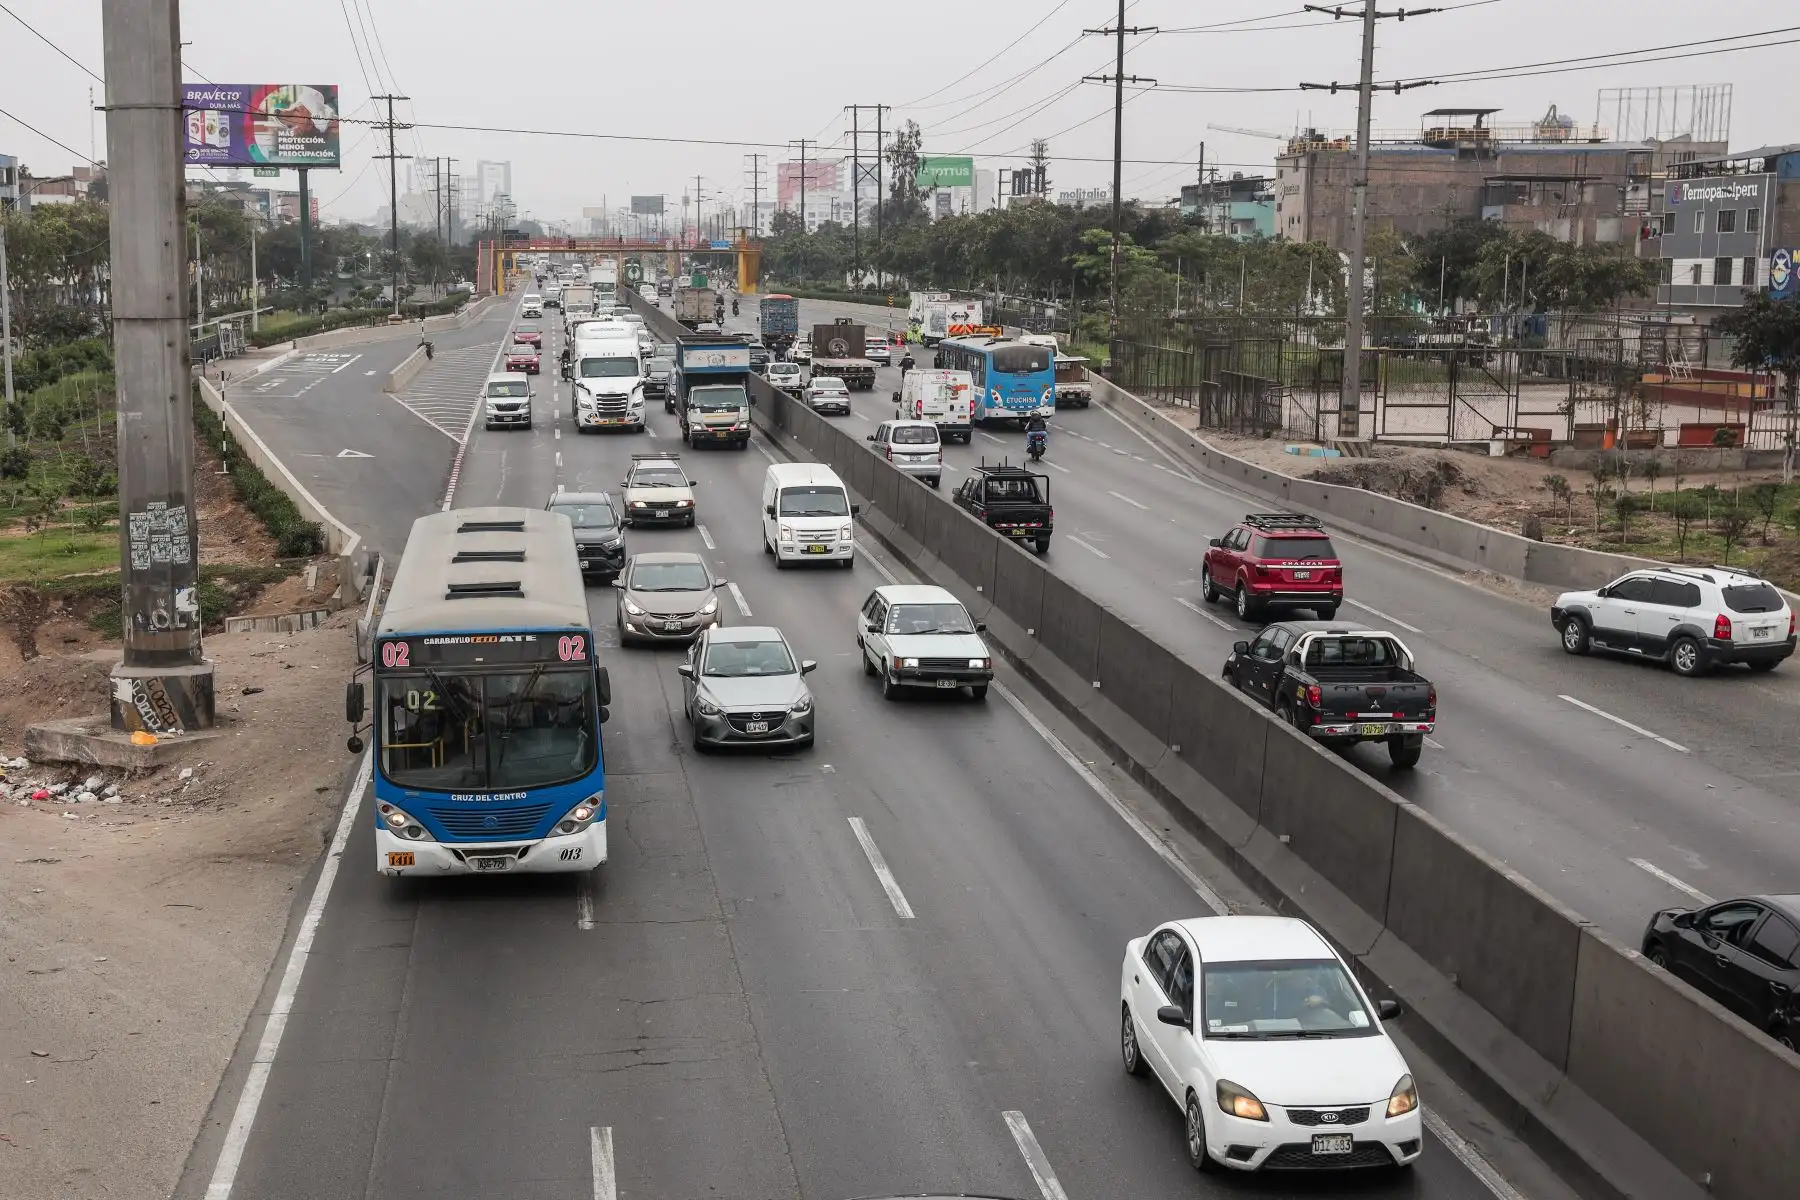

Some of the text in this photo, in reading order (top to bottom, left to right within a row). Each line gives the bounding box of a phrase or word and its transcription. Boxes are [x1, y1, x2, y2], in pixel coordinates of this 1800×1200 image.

[187, 89, 240, 103] BRAVECTO
[930, 167, 970, 177] TOTTUS
[1006, 396, 1036, 404] ETUCHISA
[424, 637, 470, 645] CARABAYLLO
[382, 641, 410, 668] 02
[558, 636, 586, 662] 02
[407, 690, 437, 712] 02
[451, 792, 527, 802] CRUZ DEL CENTRO
[560, 848, 581, 861] 013
